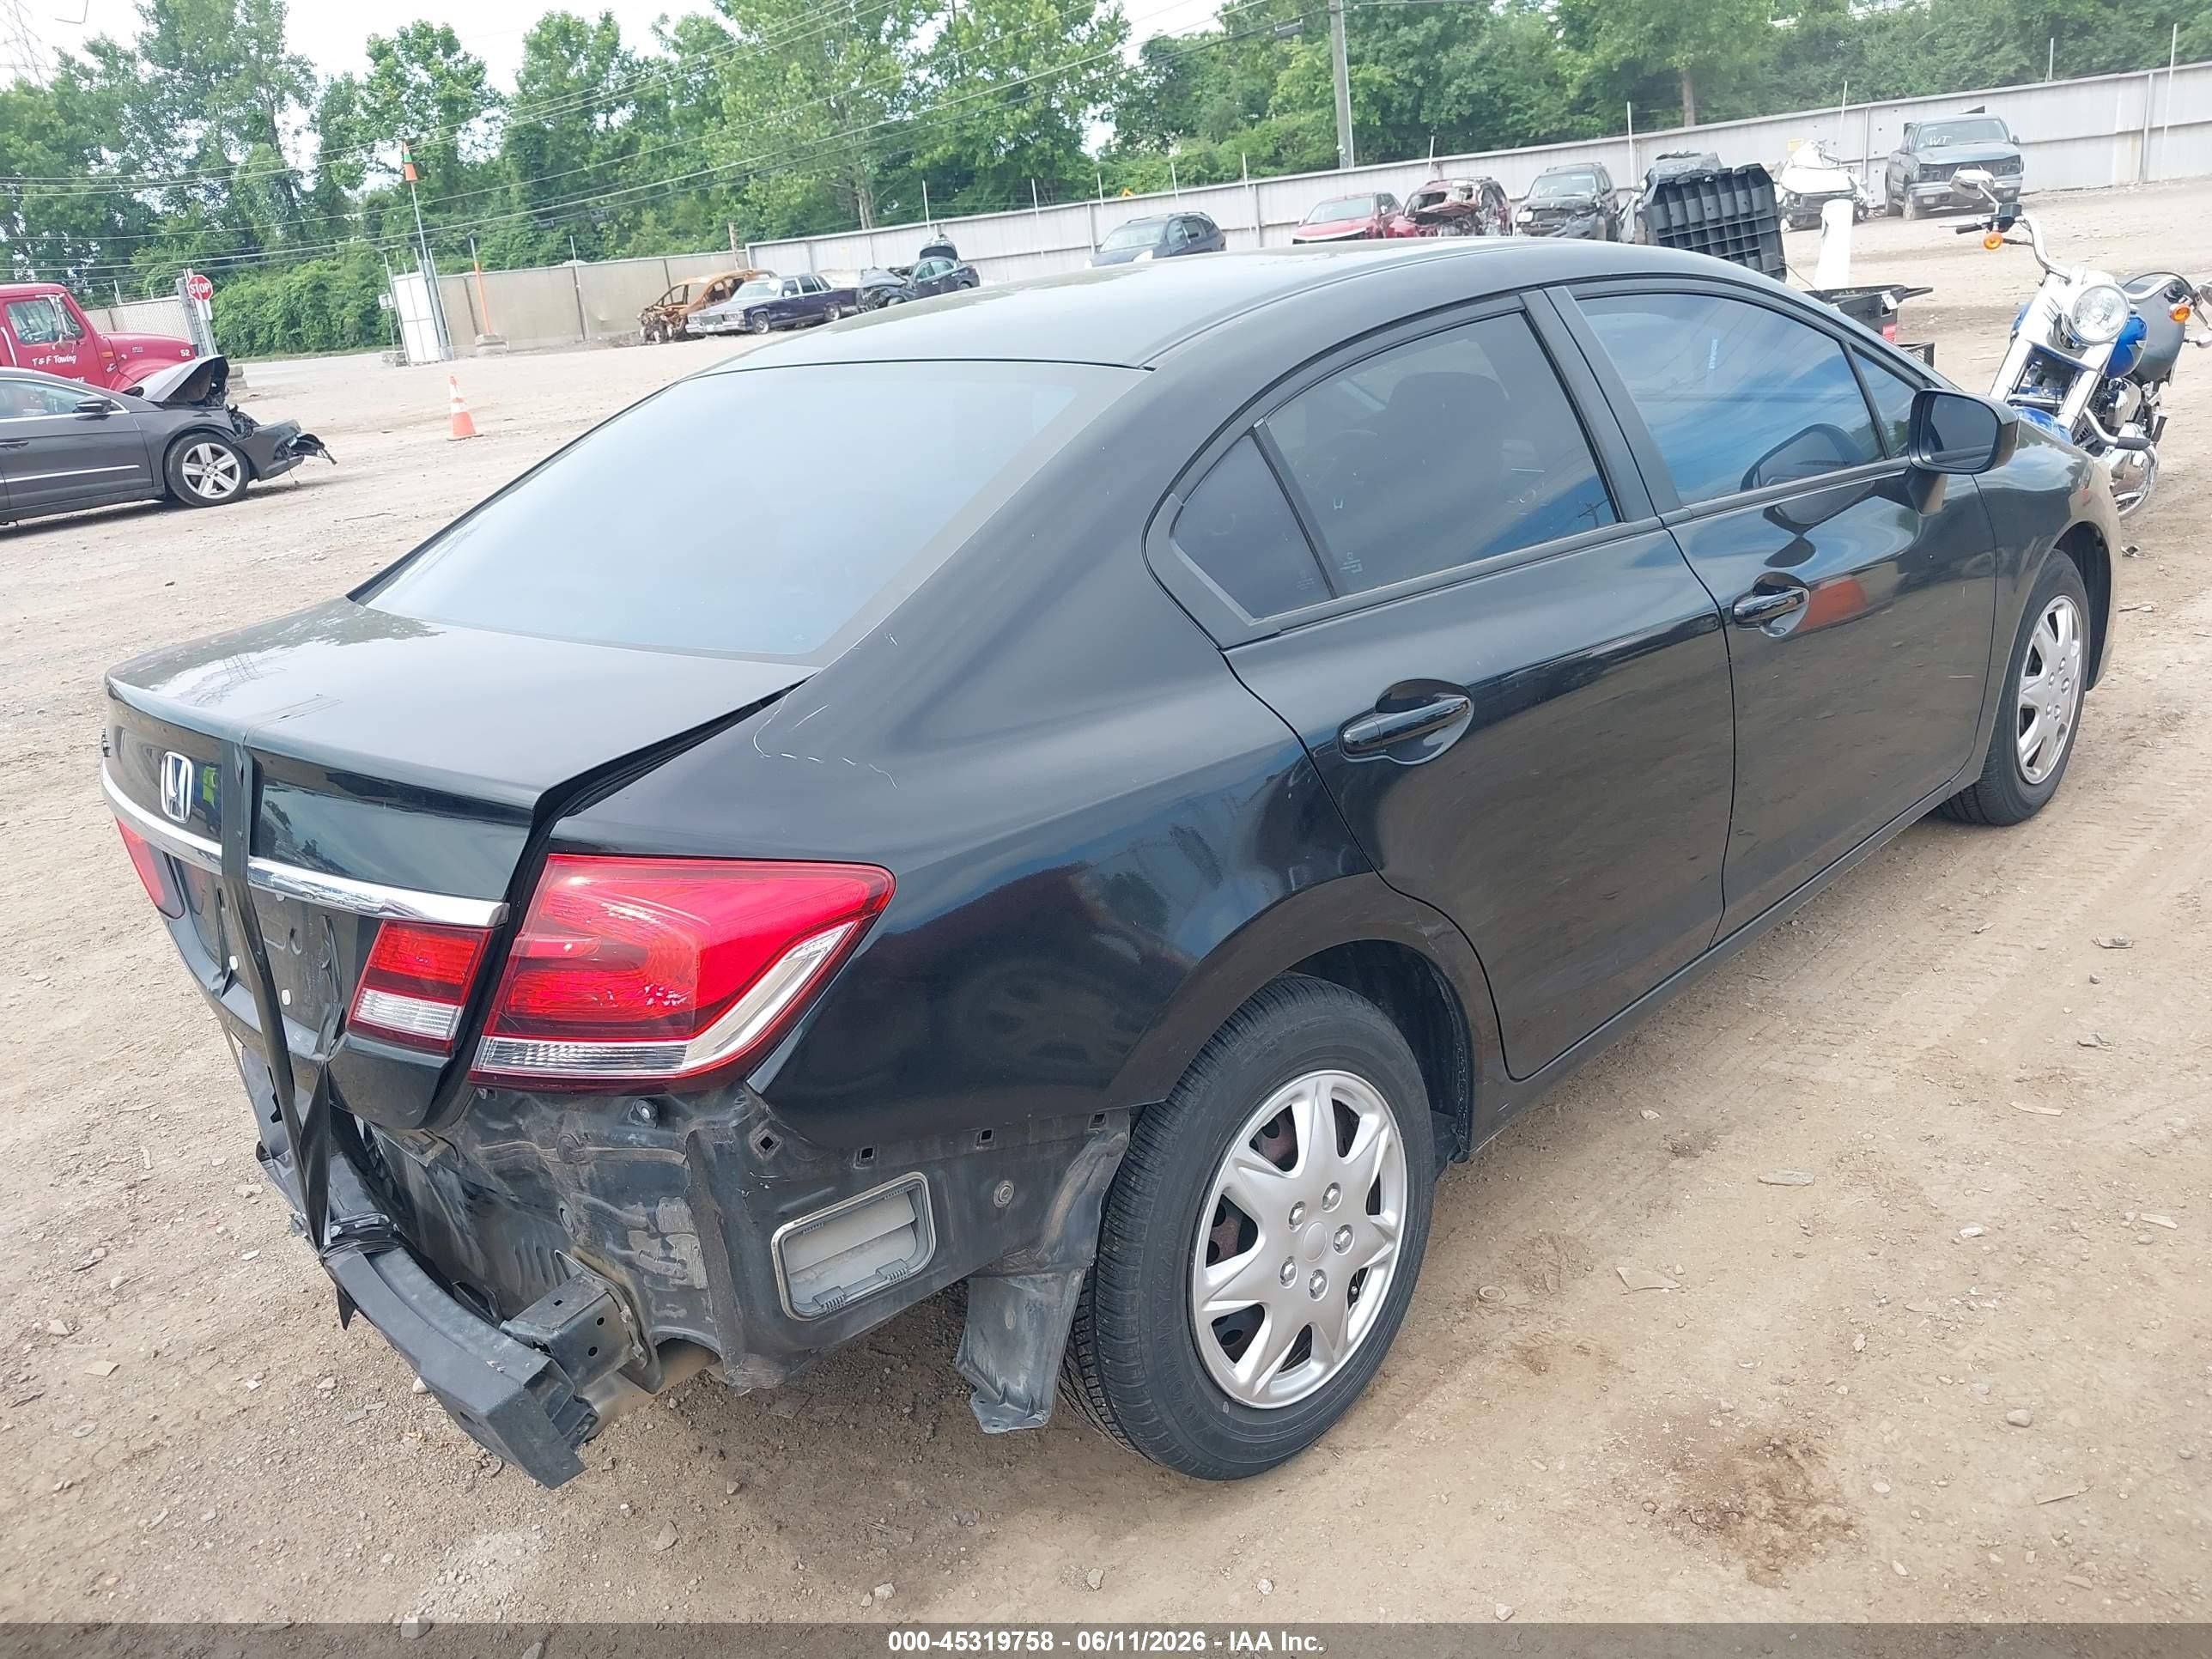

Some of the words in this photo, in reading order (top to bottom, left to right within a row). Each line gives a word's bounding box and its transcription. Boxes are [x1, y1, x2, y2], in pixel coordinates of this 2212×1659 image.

[189, 283, 210, 294] STOP
[179, 349, 191, 357] 52
[32, 357, 38, 367] T
[46, 355, 52, 365] F
[53, 354, 76, 364] Towing
